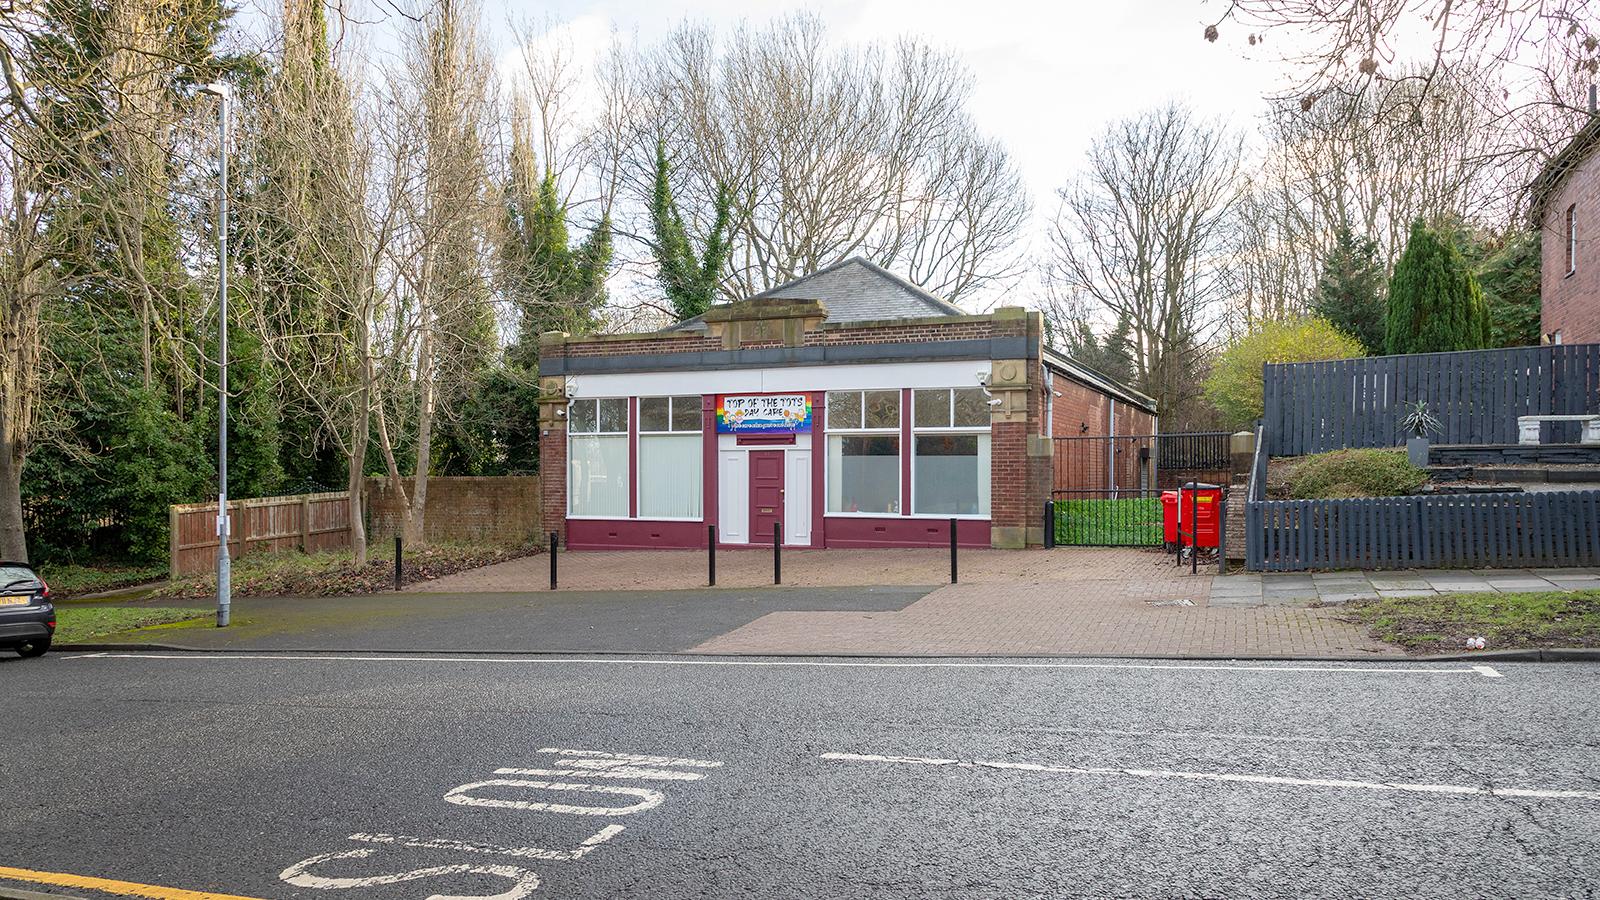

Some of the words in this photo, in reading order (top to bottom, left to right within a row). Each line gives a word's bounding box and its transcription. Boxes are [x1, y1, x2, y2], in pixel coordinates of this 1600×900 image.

[727, 399, 745, 408] TOP
[748, 398, 759, 407] OF
[761, 398, 778, 407] THE
[780, 397, 803, 407] TOTS
[744, 408, 759, 416] DAY
[763, 408, 783, 416] CARE
[279, 748, 724, 900] SLOW
